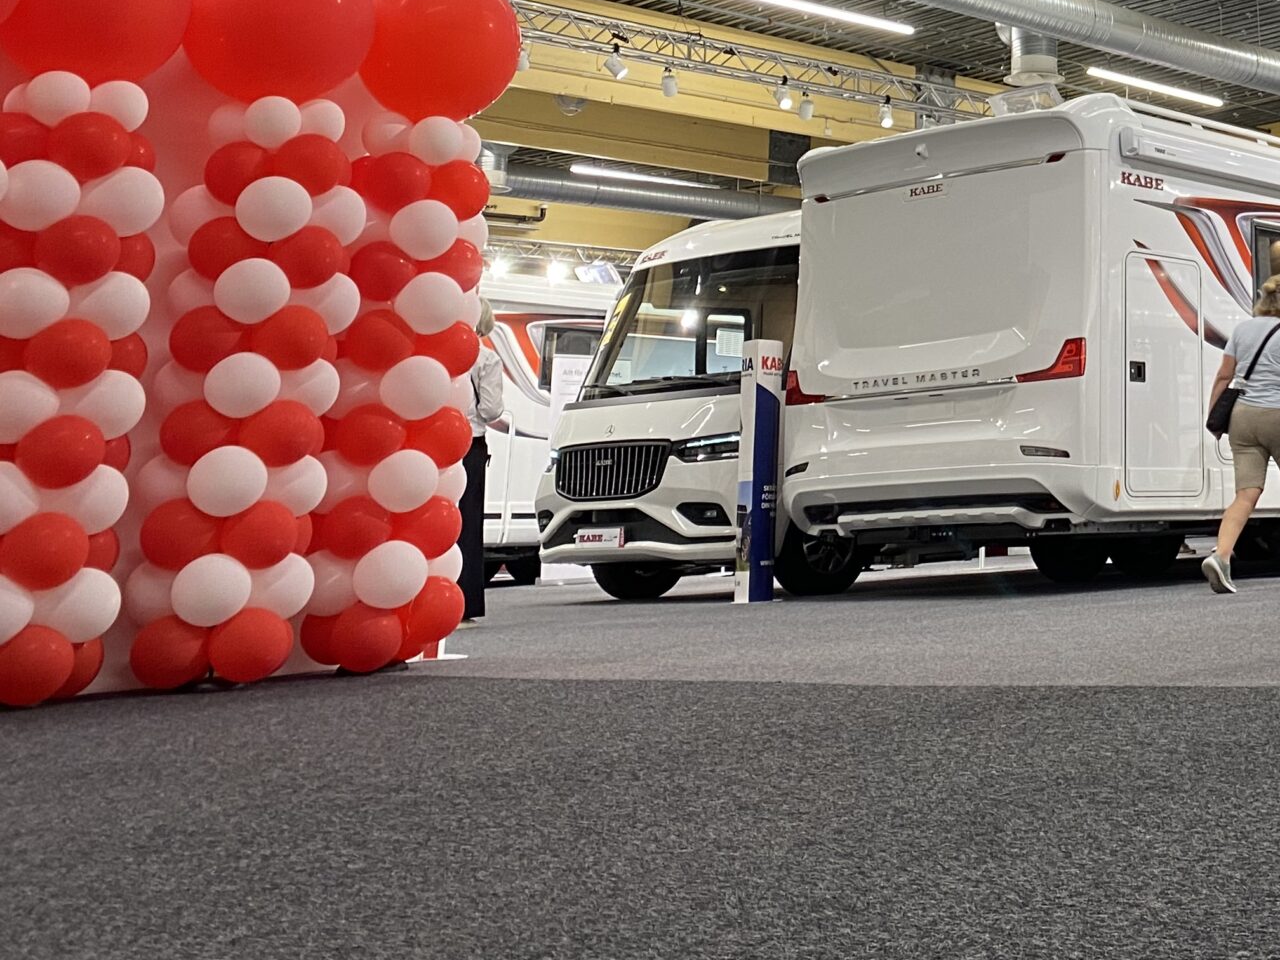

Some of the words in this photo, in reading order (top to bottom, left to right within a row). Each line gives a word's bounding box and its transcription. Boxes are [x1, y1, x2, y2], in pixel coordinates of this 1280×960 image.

[1121, 171, 1164, 191] KABE
[910, 183, 943, 197] KABE
[761, 356, 783, 370] KAB
[853, 377, 908, 390] TRAVEL
[916, 369, 980, 383] MASTER
[578, 534, 603, 543] KABE
